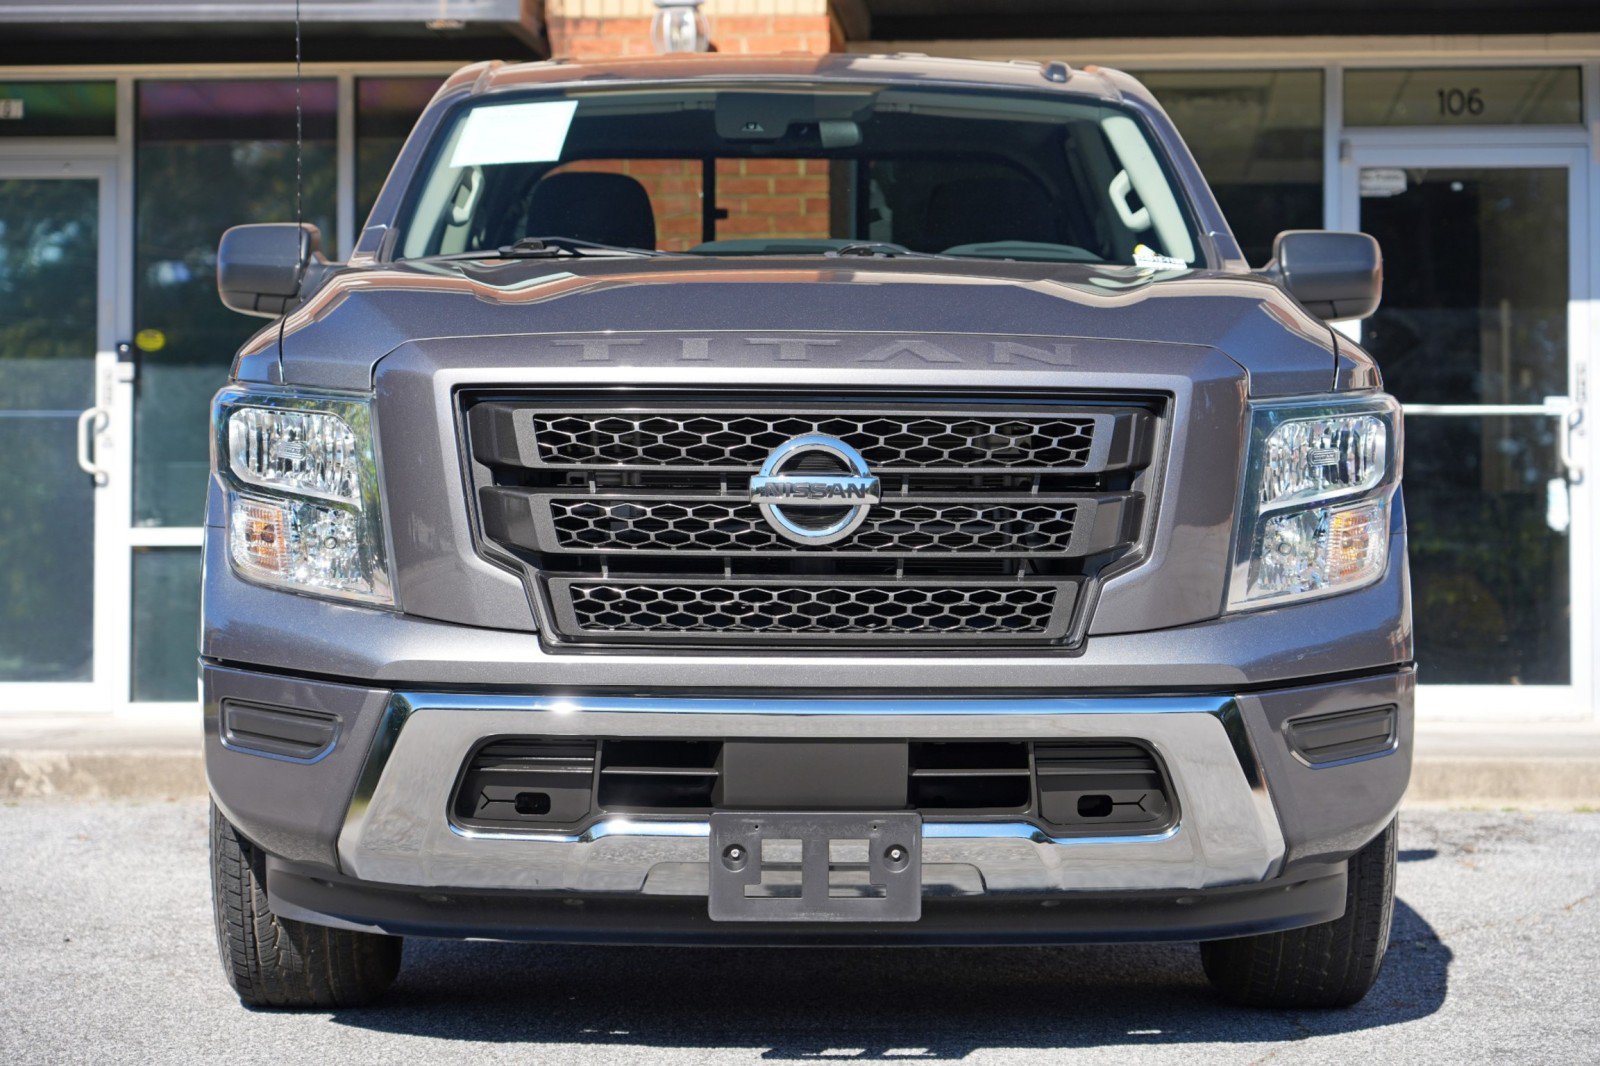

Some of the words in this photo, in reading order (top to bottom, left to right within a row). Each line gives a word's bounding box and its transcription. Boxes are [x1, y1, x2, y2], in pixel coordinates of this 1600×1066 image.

[1437, 88, 1484, 115] 106
[550, 337, 1077, 366] TITAN
[760, 482, 866, 499] NISSAN
